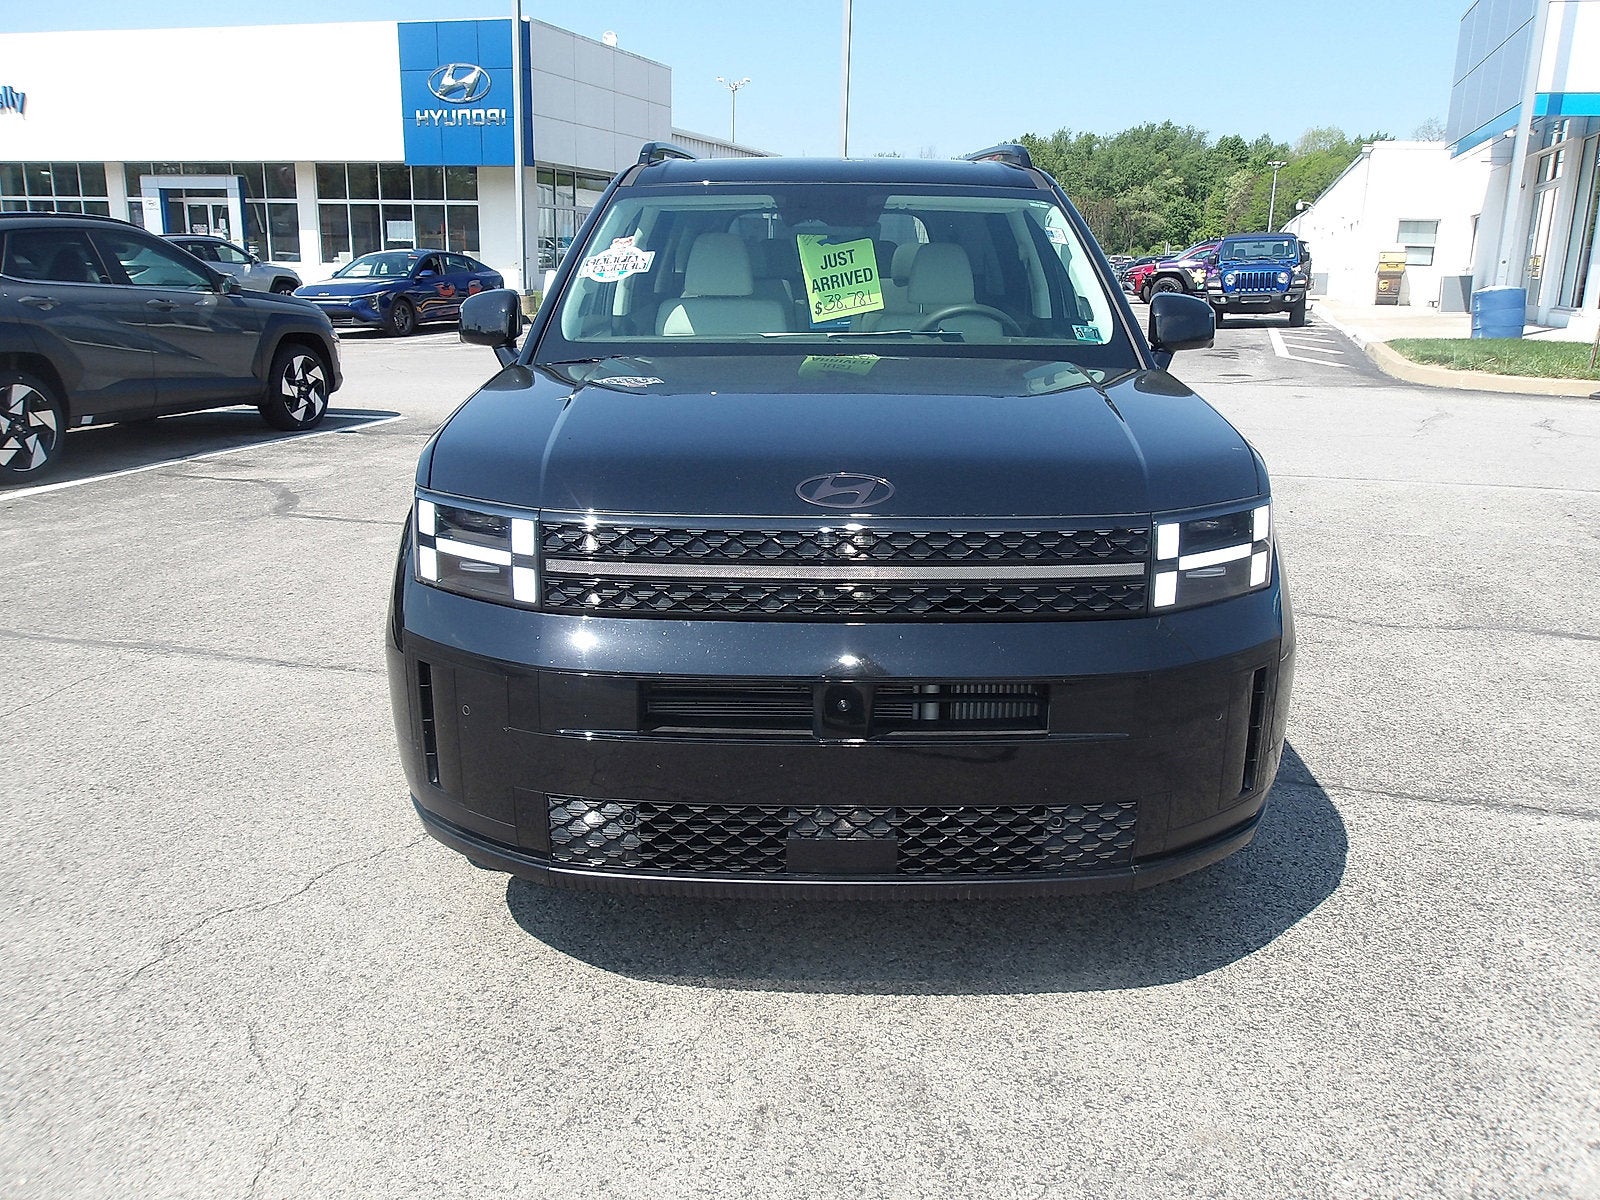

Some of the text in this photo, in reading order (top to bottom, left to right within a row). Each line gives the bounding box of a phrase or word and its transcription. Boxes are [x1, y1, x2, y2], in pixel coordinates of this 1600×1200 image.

[415, 108, 506, 127] HYUNDAI
[820, 249, 855, 270] JUST
[811, 267, 874, 294] ARRIVED
